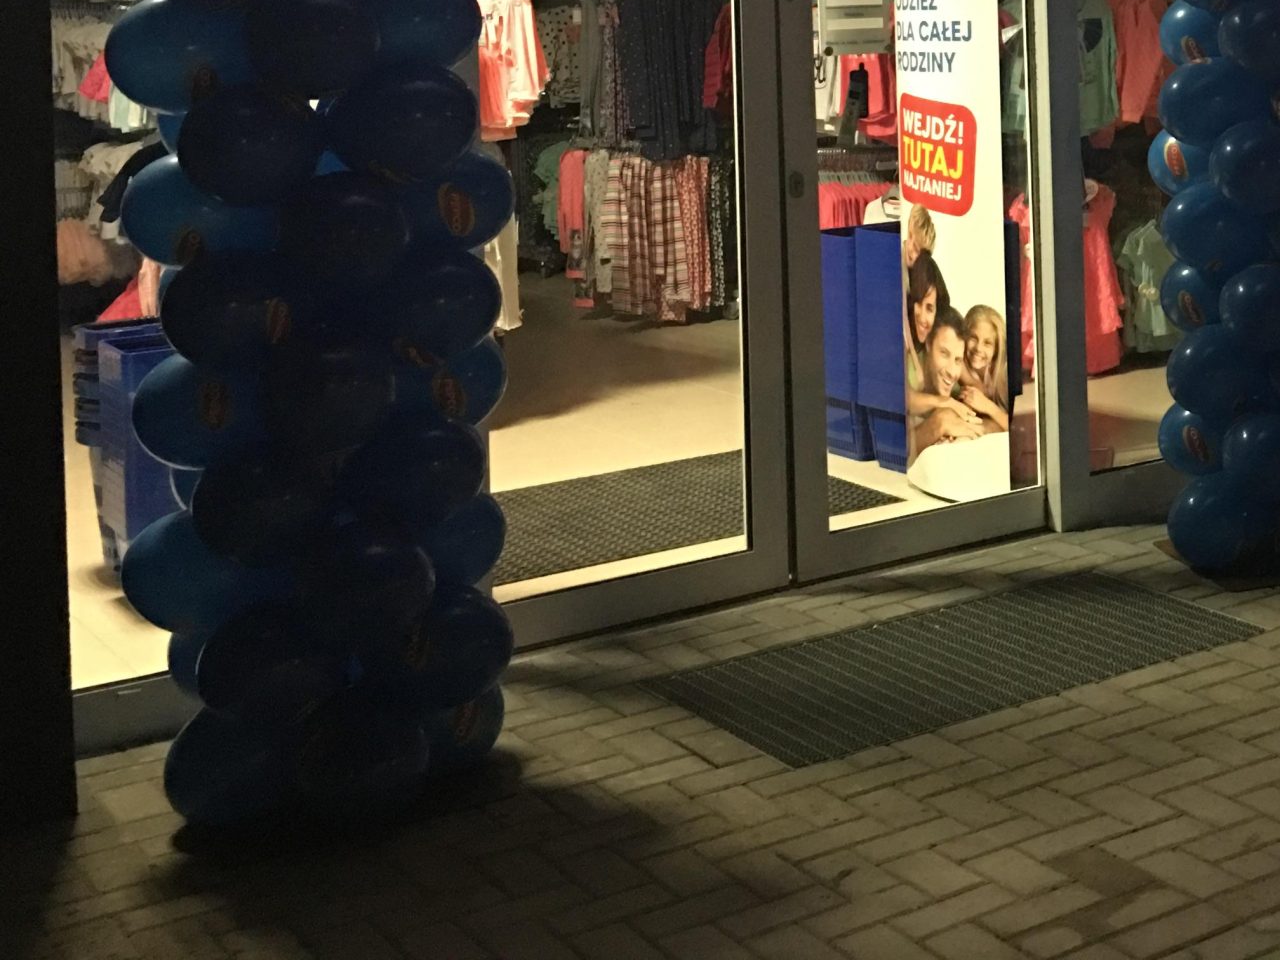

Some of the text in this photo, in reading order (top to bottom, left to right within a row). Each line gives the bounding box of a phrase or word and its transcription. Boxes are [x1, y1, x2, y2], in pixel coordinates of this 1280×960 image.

[918, 20, 972, 42] CAŁEJ
[903, 108, 964, 145] WEJDŹ!
[903, 135, 964, 179] TUTAJ
[903, 169, 962, 201] NAJTANIEJ
